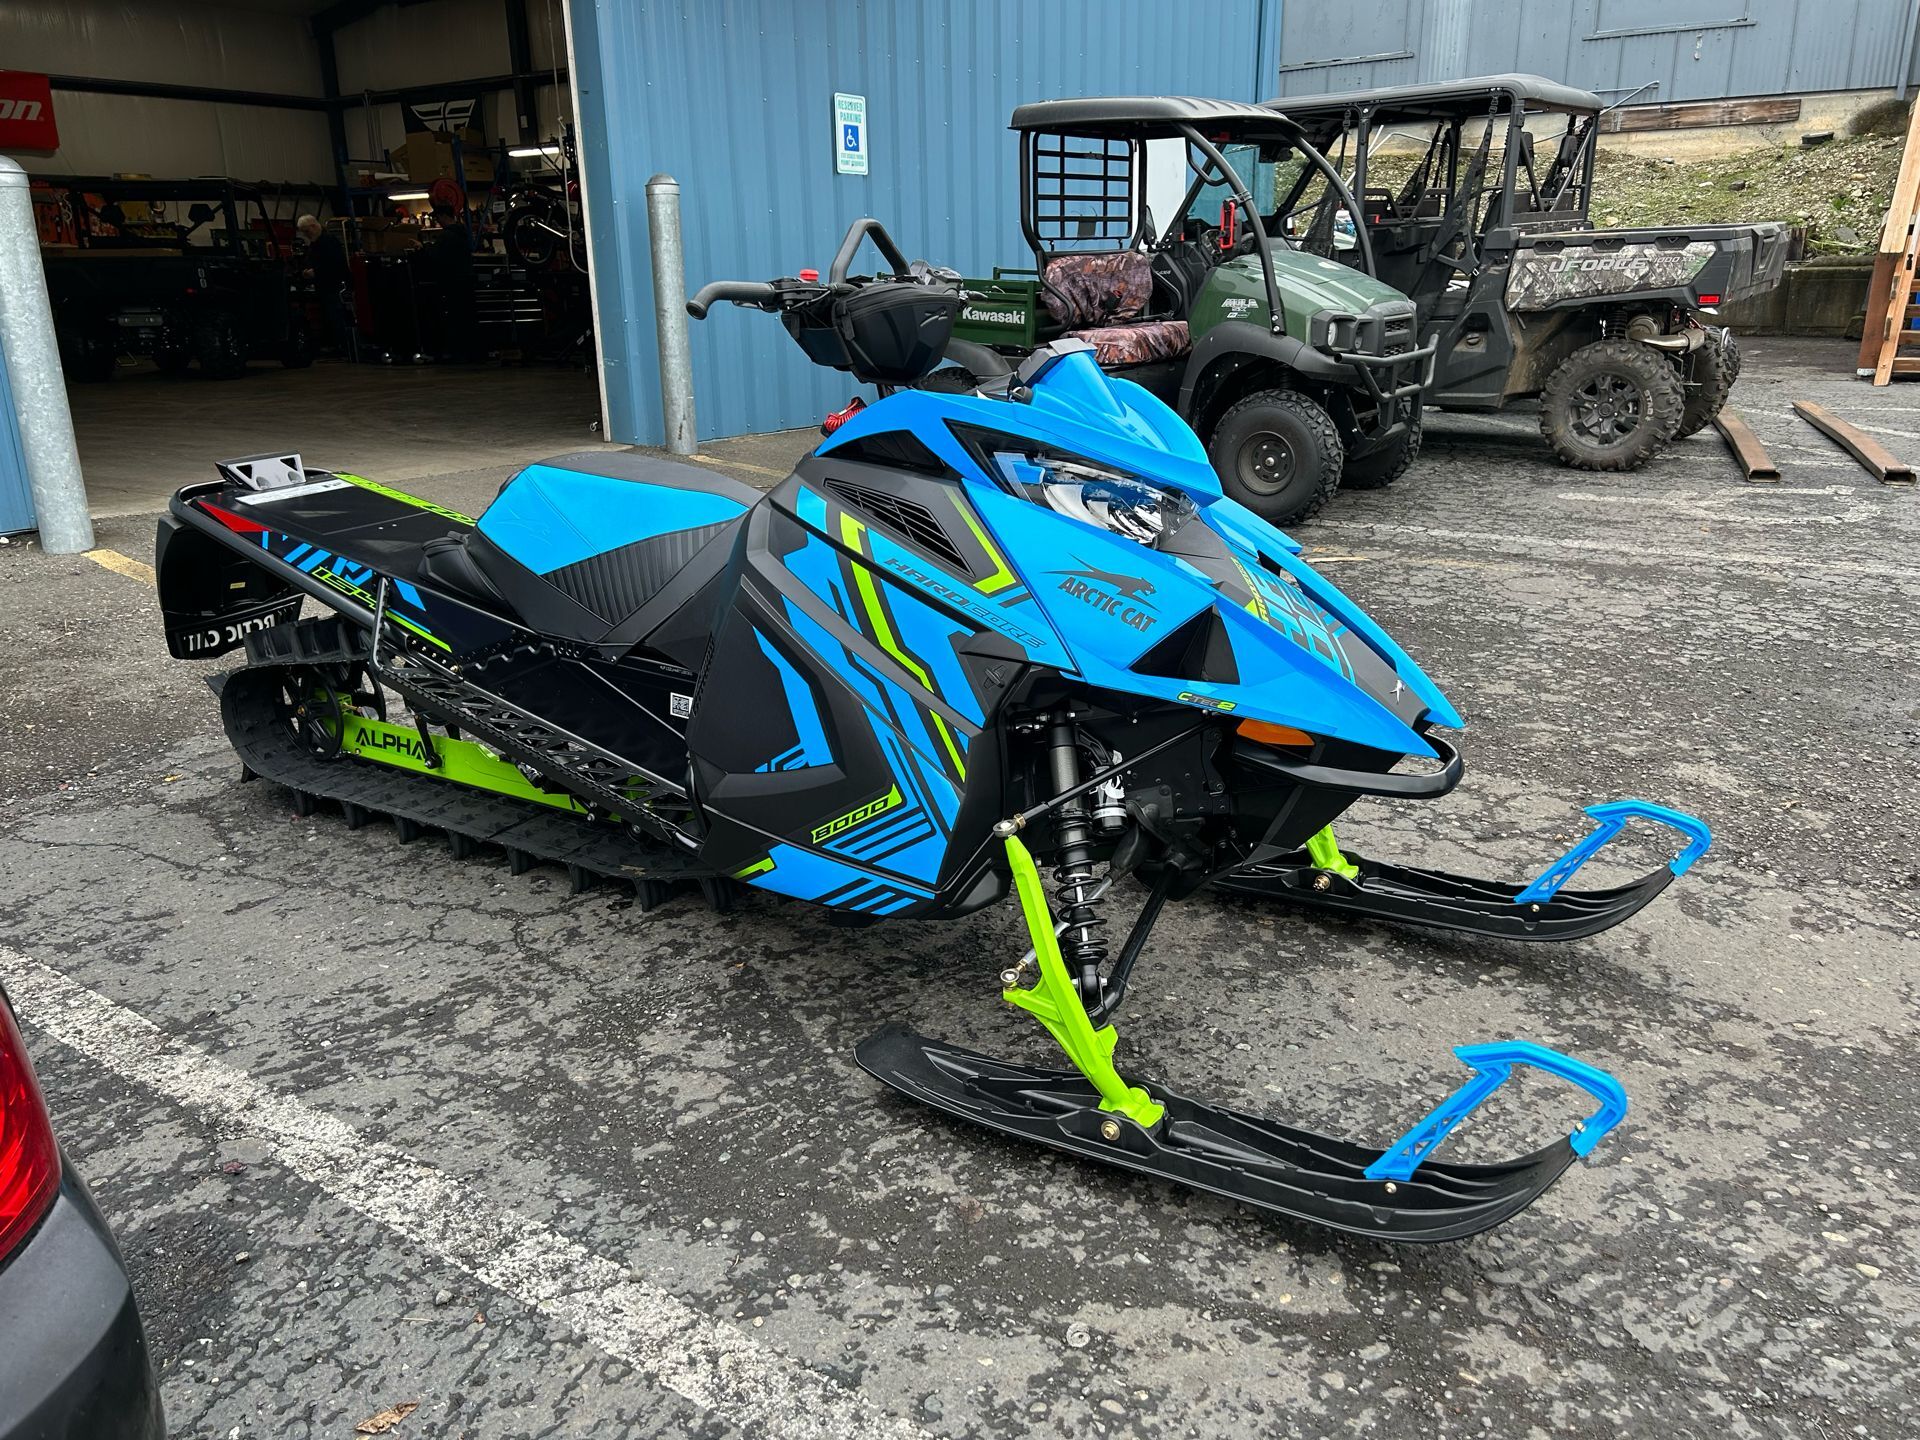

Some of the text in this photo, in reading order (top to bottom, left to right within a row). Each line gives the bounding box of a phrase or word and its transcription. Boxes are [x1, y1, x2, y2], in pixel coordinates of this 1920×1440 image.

[840, 112, 862, 123] PARKING
[1550, 257, 1650, 273] UFORCE
[962, 306, 1025, 325] Kawasaki
[1221, 298, 1259, 308] MULE
[884, 557, 1047, 649] HARDCORE
[1057, 576, 1157, 632] ARCTIC CAT
[355, 727, 426, 761] ALPHA
[815, 797, 889, 840] 8000
